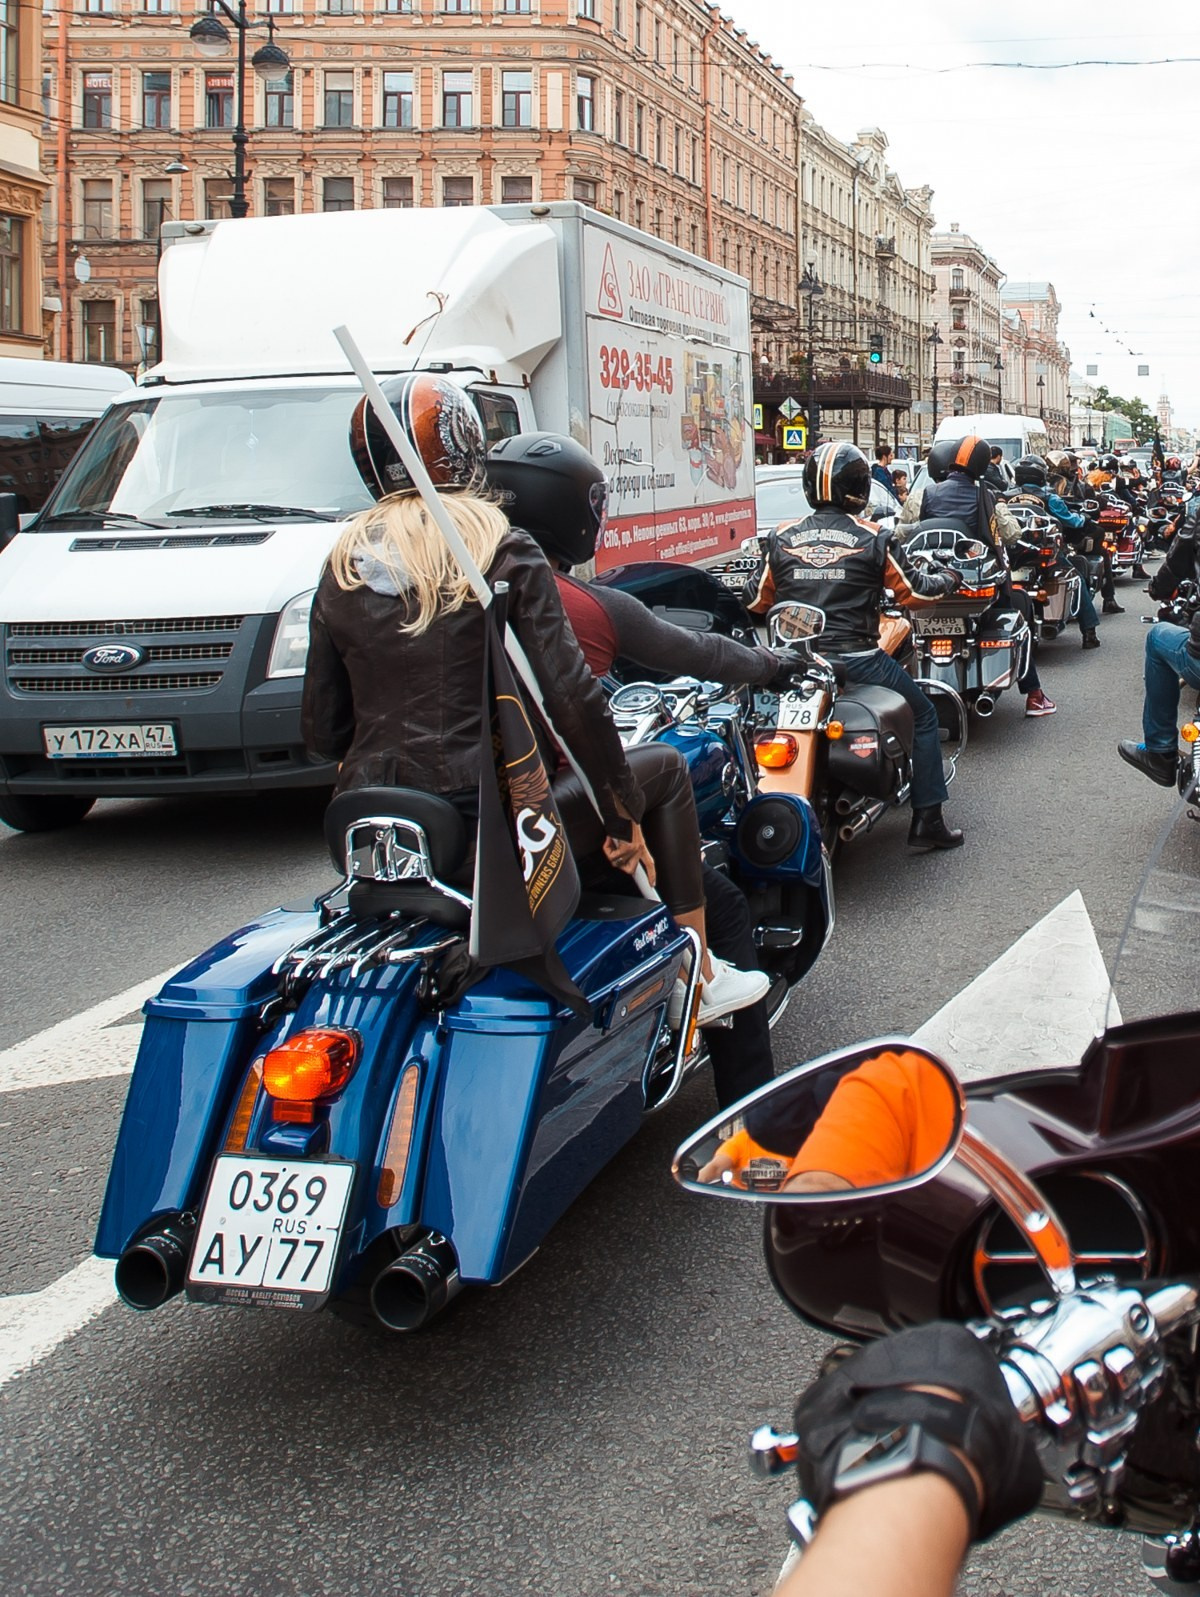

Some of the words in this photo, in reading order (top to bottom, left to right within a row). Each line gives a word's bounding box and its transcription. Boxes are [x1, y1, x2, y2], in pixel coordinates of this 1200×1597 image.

[86, 78, 111, 88] HOTEL
[628, 260, 650, 302] ЗАО
[793, 568, 846, 580] MOTORCYCLES
[93, 649, 125, 664] Ford
[789, 710, 811, 725] 78
[532, 865, 554, 899] OWNERS
[550, 839, 563, 870] GROUP
[229, 1170, 327, 1216] 0369
[272, 1218, 307, 1234] RUS
[276, 1238, 325, 1282] 77
